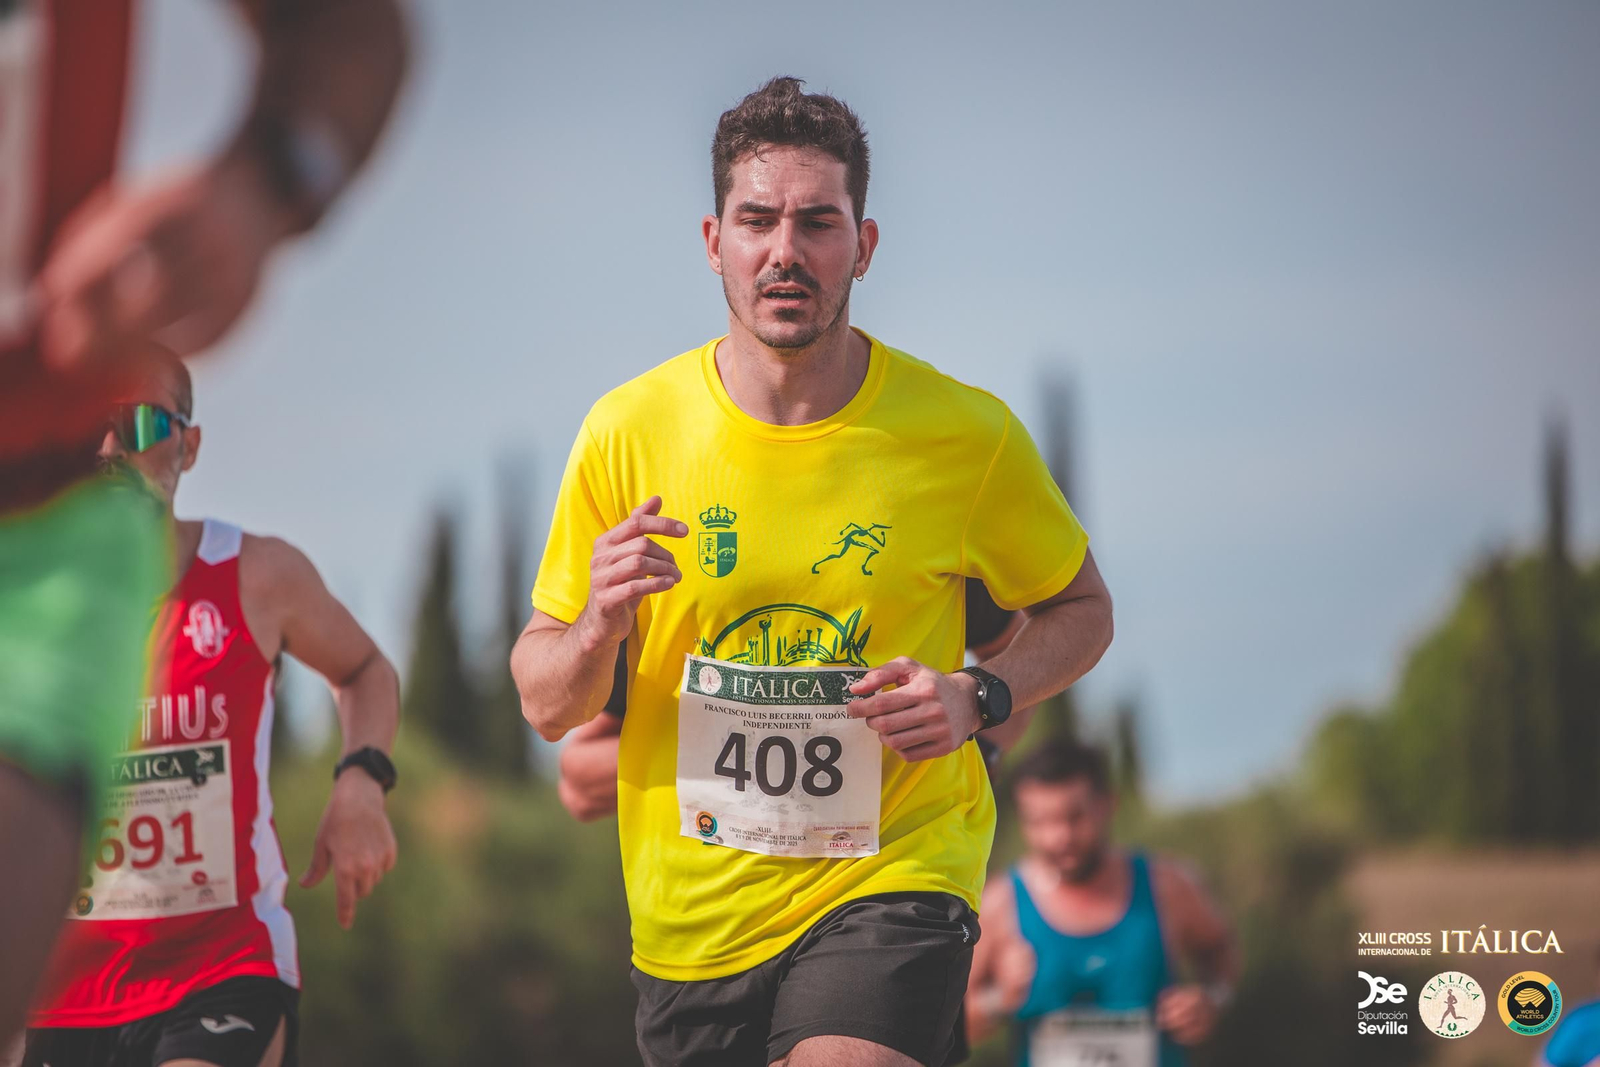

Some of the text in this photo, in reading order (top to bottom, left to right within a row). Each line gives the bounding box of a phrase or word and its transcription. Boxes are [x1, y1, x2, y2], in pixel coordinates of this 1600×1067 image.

[732, 674, 826, 698] ITÁLICA
[732, 695, 776, 704] INTERNATIONAL
[704, 703, 747, 718] FRANCISCO
[748, 711, 767, 720] LUIS
[769, 712, 814, 720] BECERRIL
[743, 720, 812, 730] INDEPENDIENTE
[714, 732, 843, 797] 408
[95, 811, 203, 872] 691
